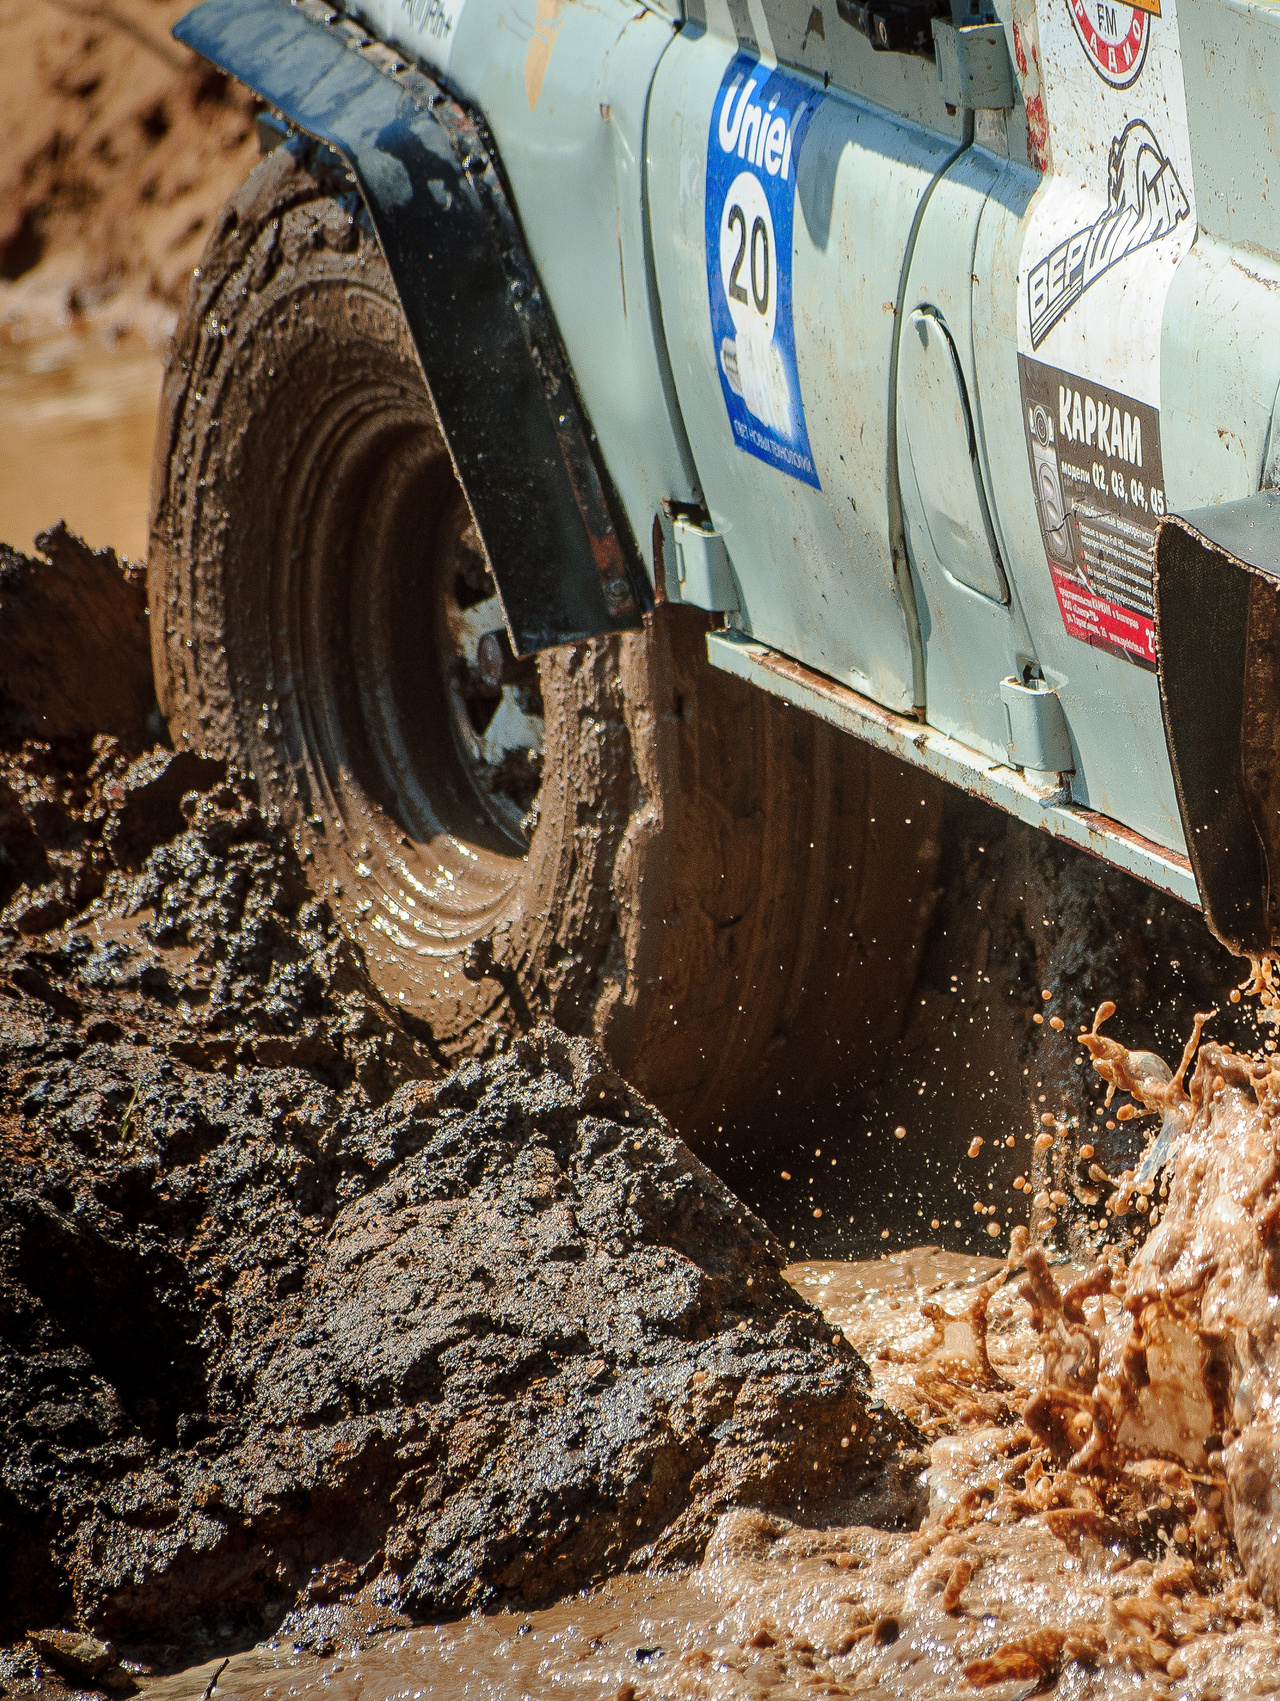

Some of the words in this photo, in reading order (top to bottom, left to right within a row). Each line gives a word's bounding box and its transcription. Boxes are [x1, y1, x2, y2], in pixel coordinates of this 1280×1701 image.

[718, 72, 809, 182] Uniel
[727, 203, 770, 316] 20
[1059, 385, 1143, 468] КАРКАМ
[1061, 460, 1091, 484] модели
[1092, 461, 1110, 496] Q2,
[1111, 469, 1129, 504] Q3,
[1150, 486, 1165, 516] Q5
